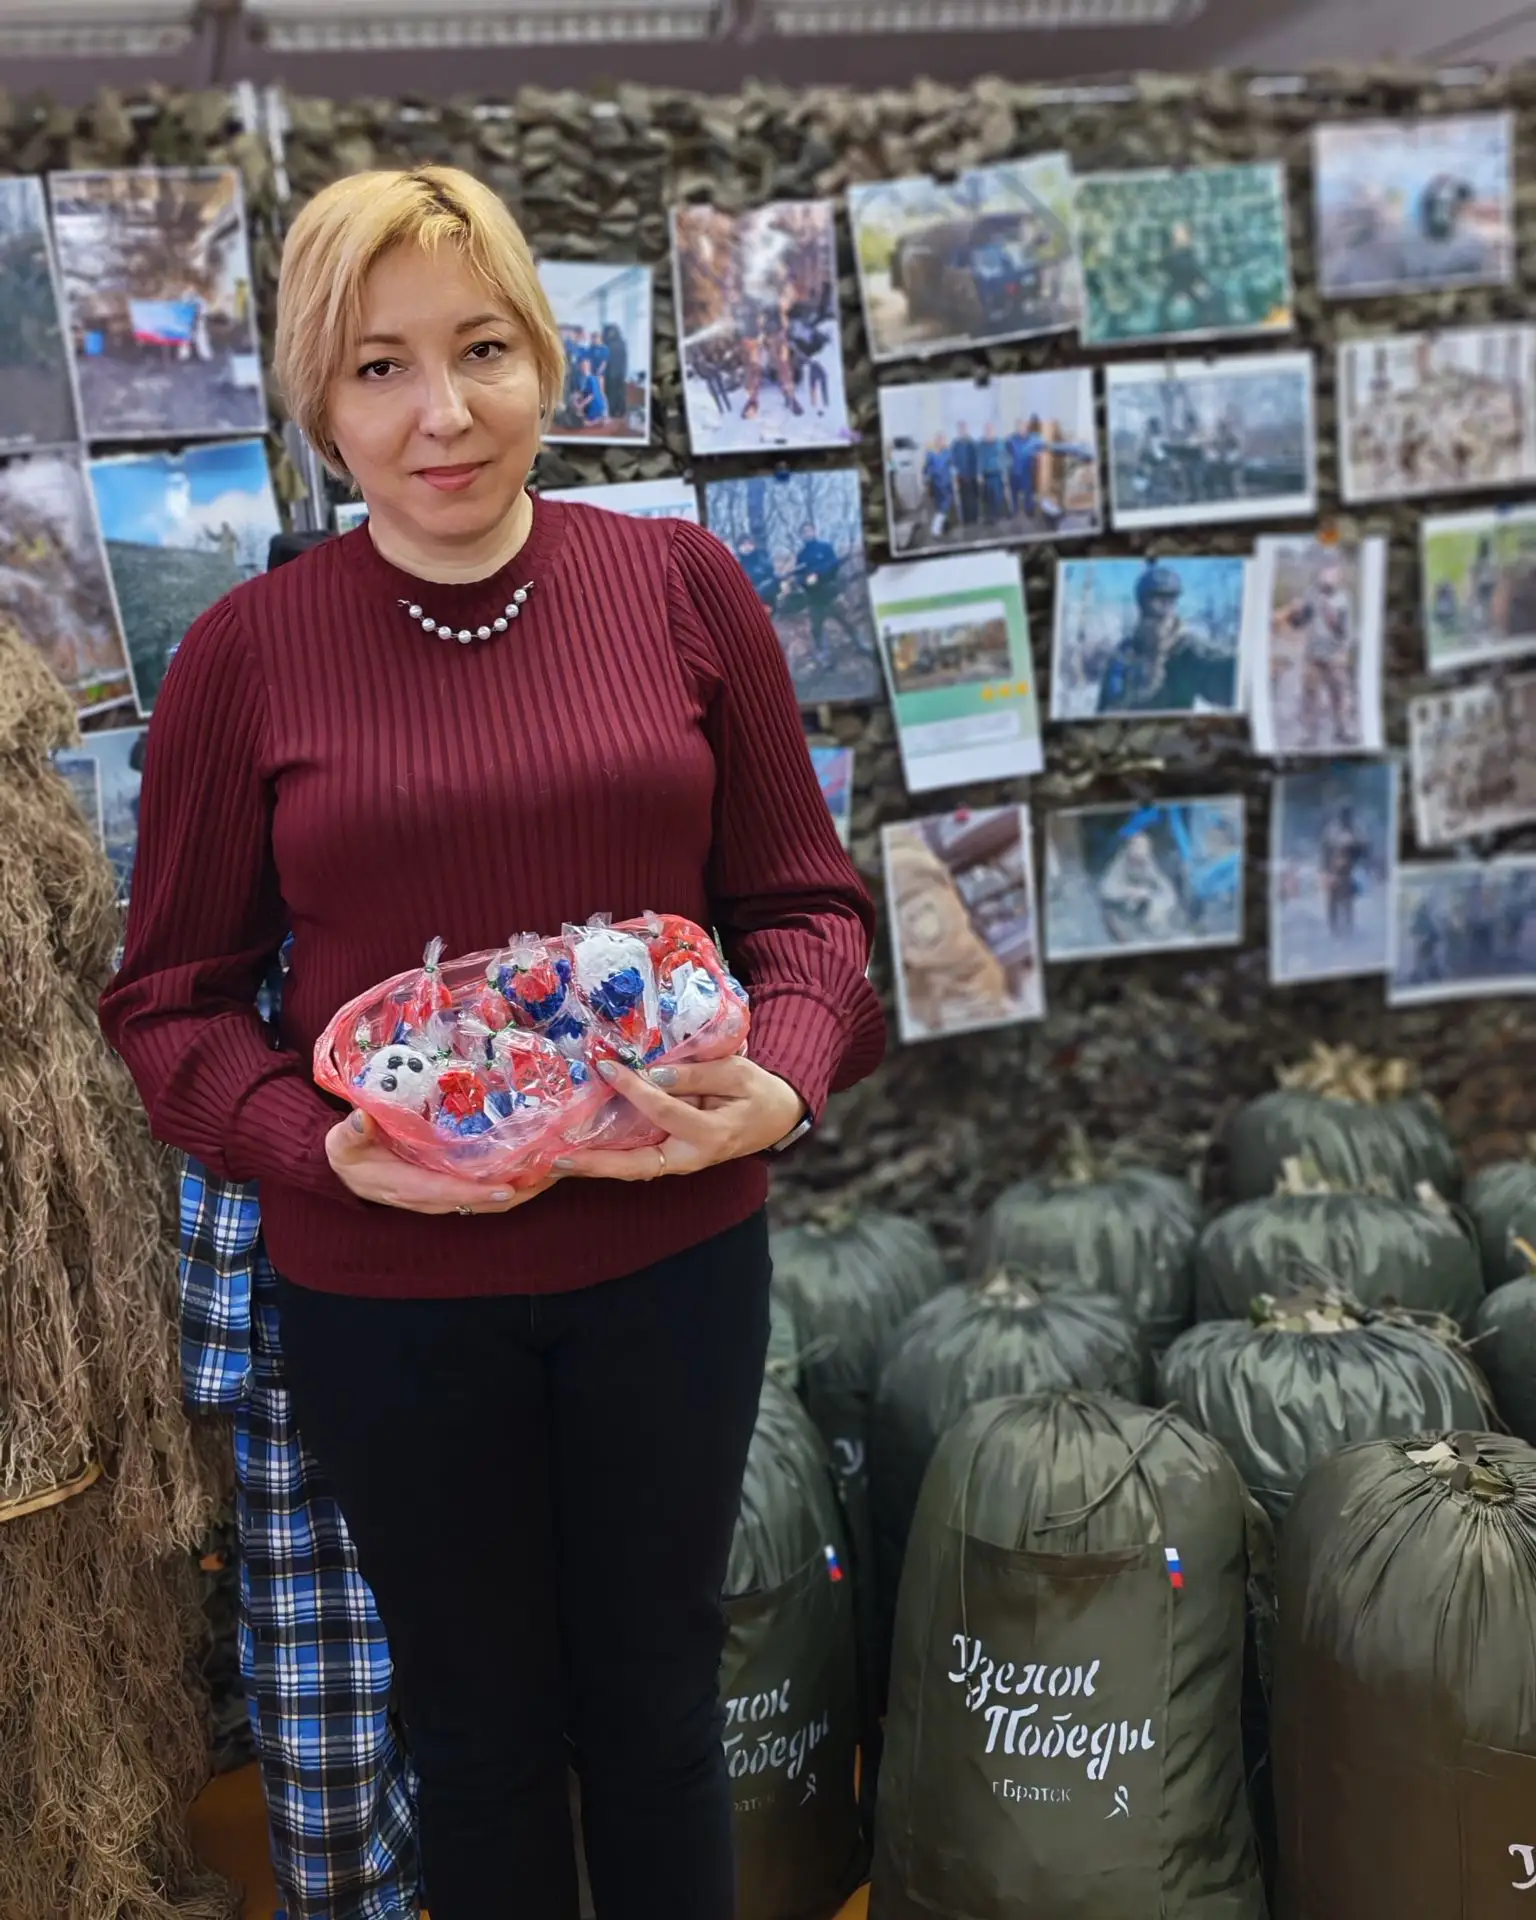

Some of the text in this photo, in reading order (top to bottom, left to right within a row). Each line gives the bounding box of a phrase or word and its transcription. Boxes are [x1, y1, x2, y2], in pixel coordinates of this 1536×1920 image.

[725, 1678, 791, 1727] лок
[949, 1634, 1101, 1712] Узелок
[984, 1703, 1156, 1781] Победы
[1003, 1779, 1072, 1802] Братск
